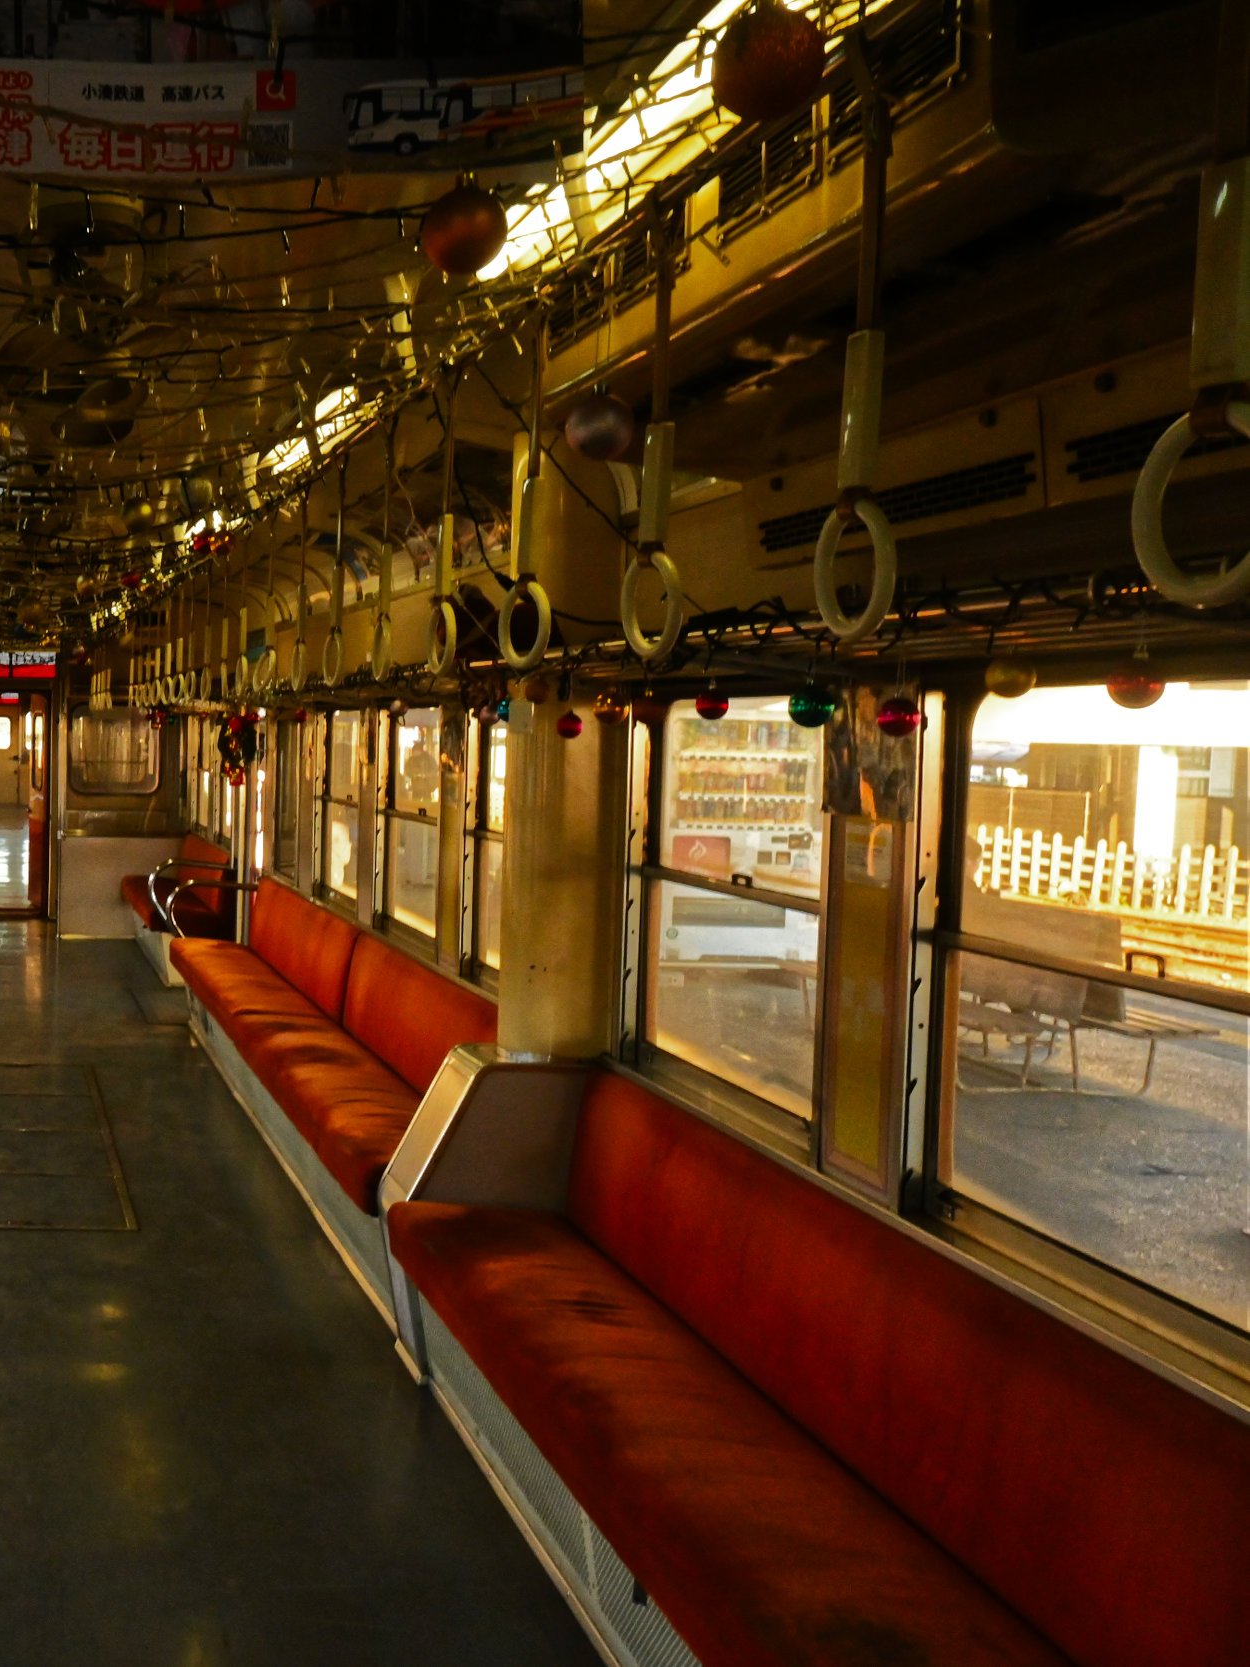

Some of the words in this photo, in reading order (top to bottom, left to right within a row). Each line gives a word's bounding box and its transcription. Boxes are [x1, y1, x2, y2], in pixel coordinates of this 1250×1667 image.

[82, 83, 145, 102] 小湊鉄道
[162, 84, 226, 102] 高速バス
[59, 121, 240, 172] 毎日運行
